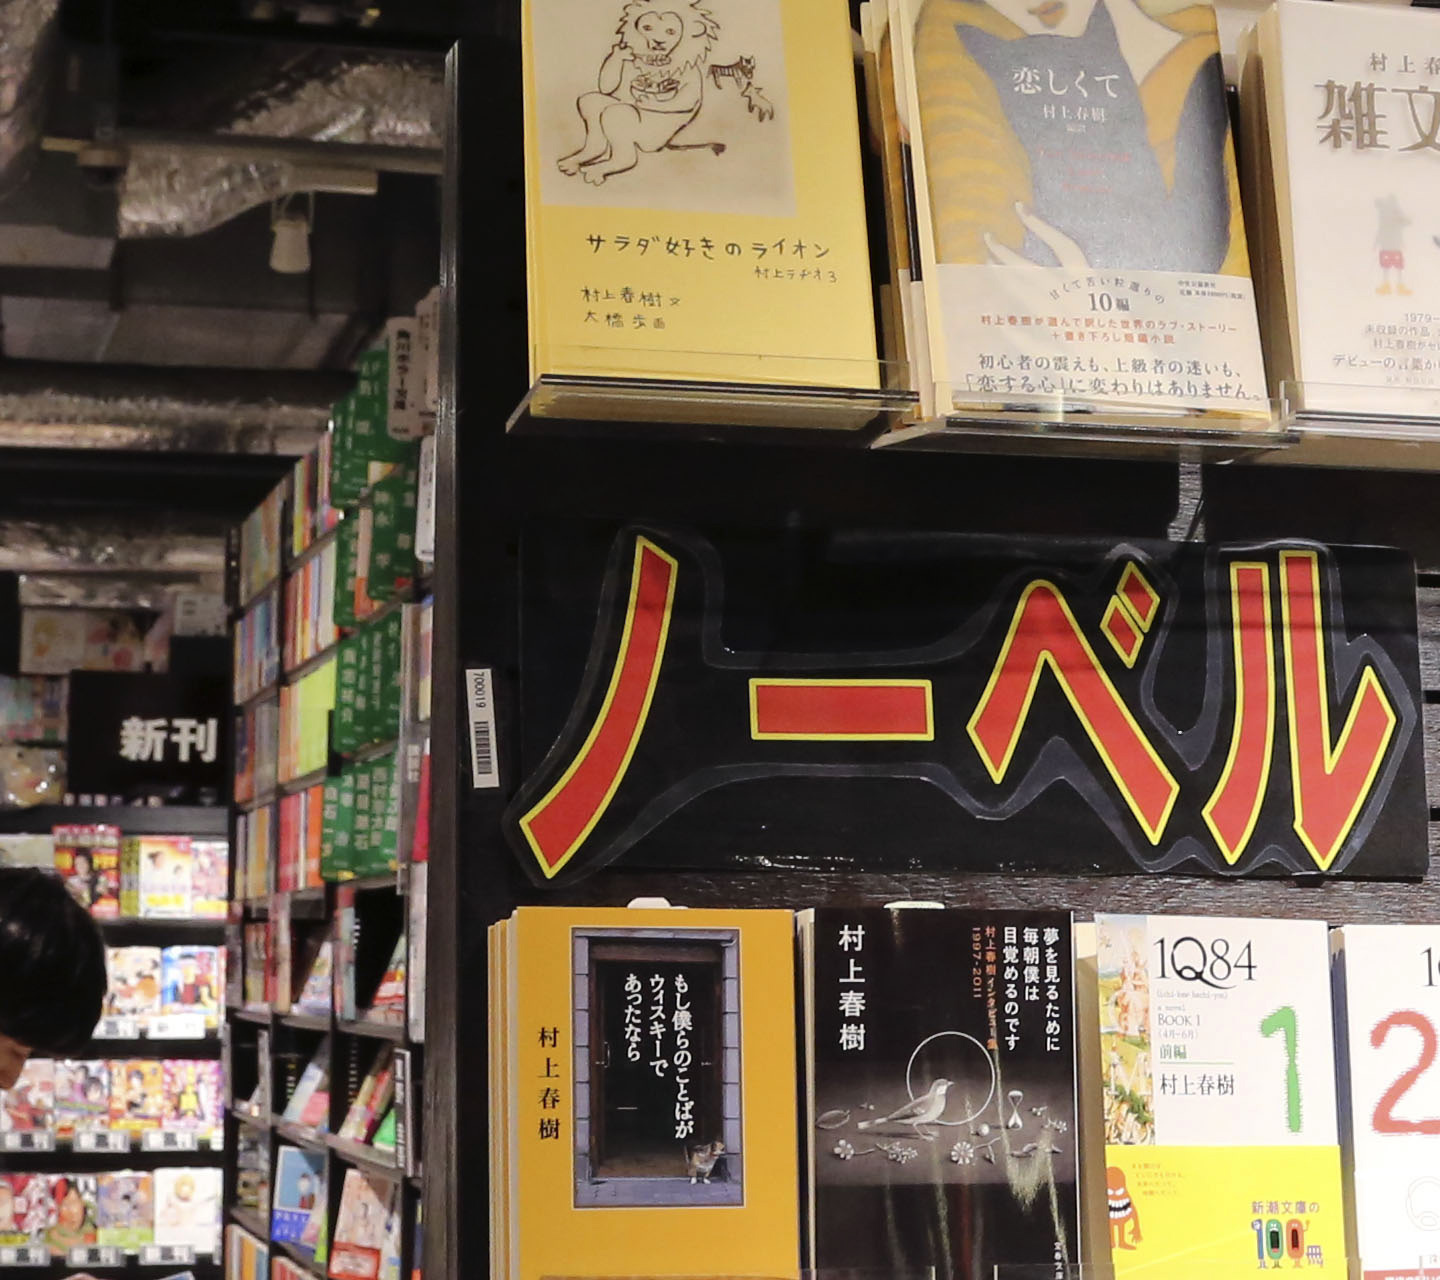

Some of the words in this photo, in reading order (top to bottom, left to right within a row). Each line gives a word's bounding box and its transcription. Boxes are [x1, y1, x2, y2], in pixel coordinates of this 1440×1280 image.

[1011, 67, 1120, 99] 恋しくて
[586, 234, 830, 260] サラダ好きのライオン
[472, 671, 487, 709] 700019
[515, 535, 1397, 880] ノーベル
[119, 716, 218, 764] 新刊
[838, 924, 867, 1051] 村上春樹
[1003, 926, 1021, 1051] 目覚めるのです
[1023, 926, 1040, 1001] 毎朝僕は
[1042, 926, 1062, 1052] 夢を見るために
[1153, 935, 1258, 990] 1Q84
[623, 973, 643, 1062] あったなら
[672, 973, 695, 1139] もし僕らのことばが
[1159, 1042, 1188, 1061] 前編
[537, 1026, 560, 1141] 村上春樹
[1260, 1005, 1302, 1133] 1
[1251, 1199, 1321, 1215] 新潮文庫の
